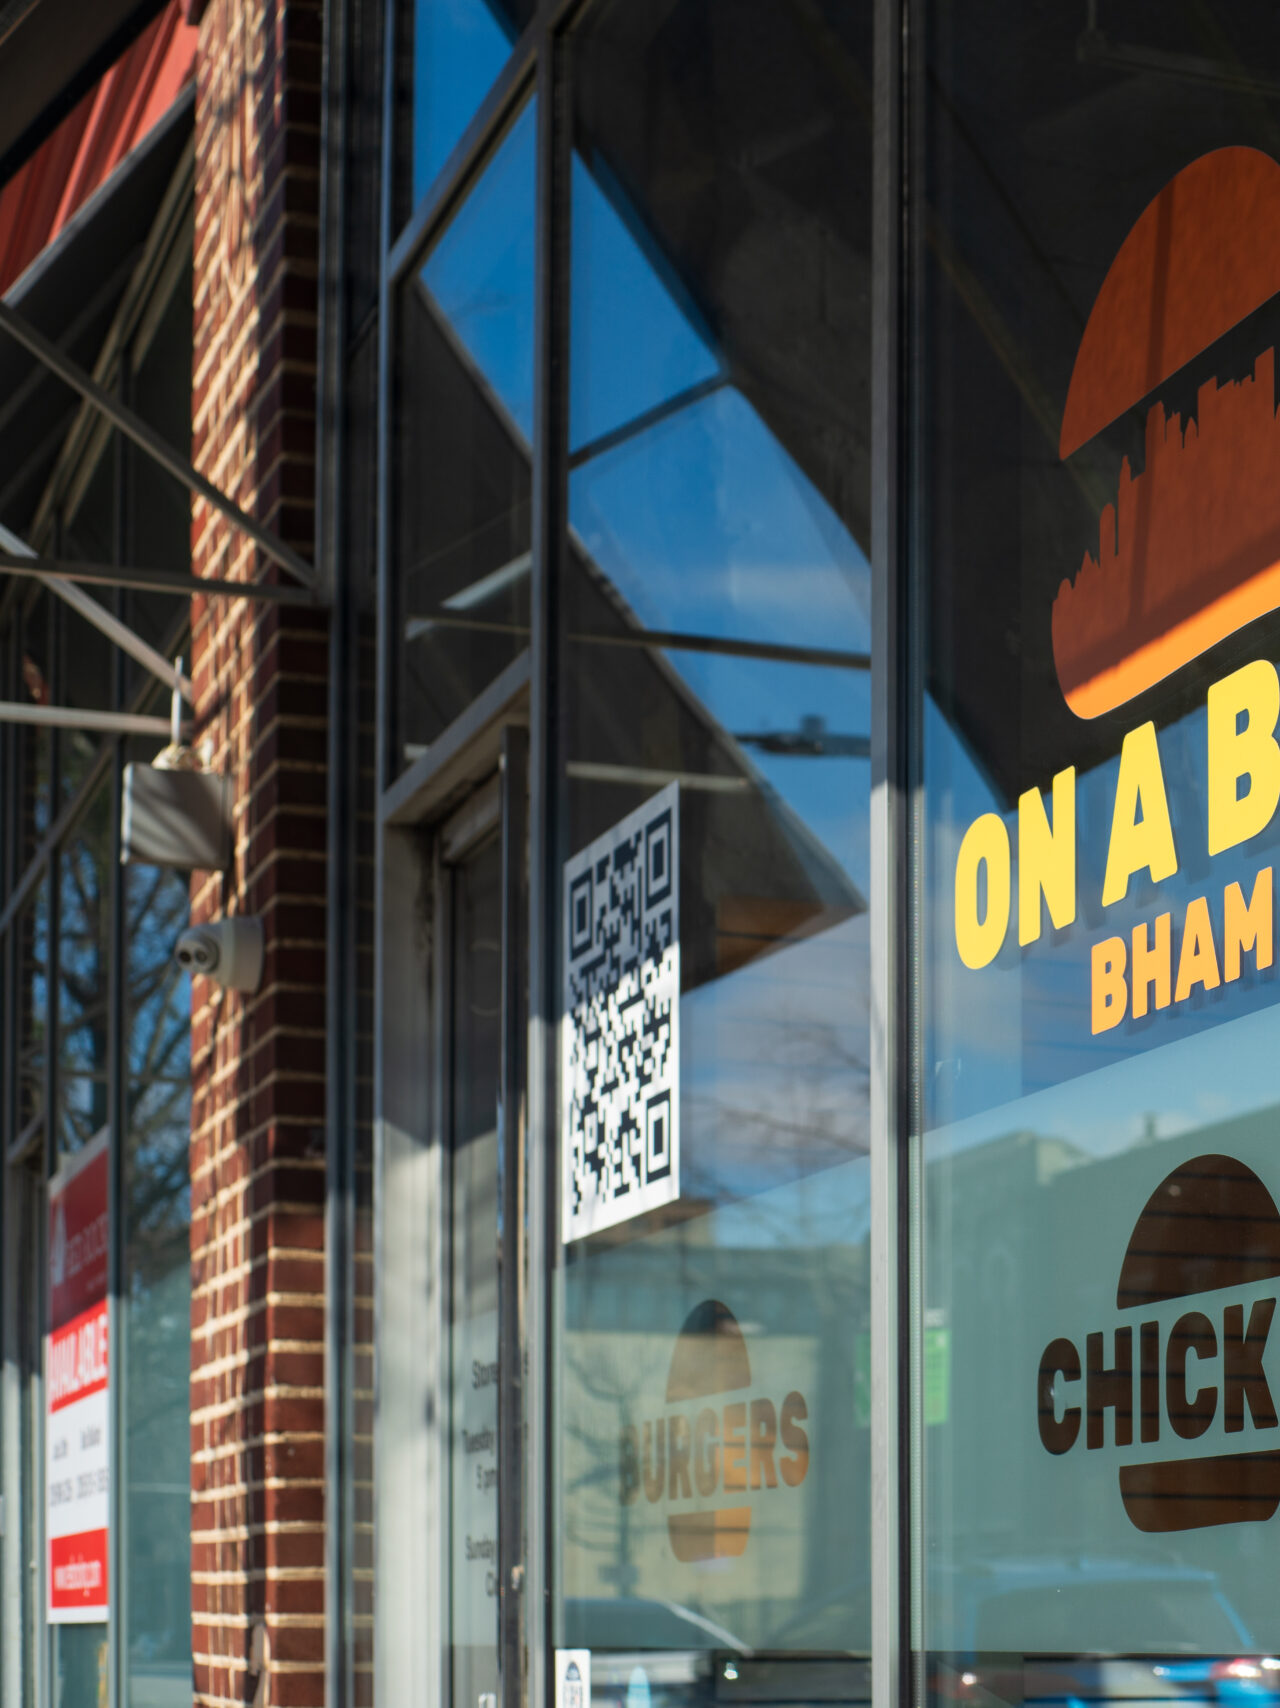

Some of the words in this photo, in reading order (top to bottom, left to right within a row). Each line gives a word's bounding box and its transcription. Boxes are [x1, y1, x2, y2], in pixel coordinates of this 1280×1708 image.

[954, 765, 1076, 970] ON
[1102, 720, 1179, 907] A
[1091, 866, 1273, 1036] BHAM
[619, 1390, 811, 1507] BURGERS
